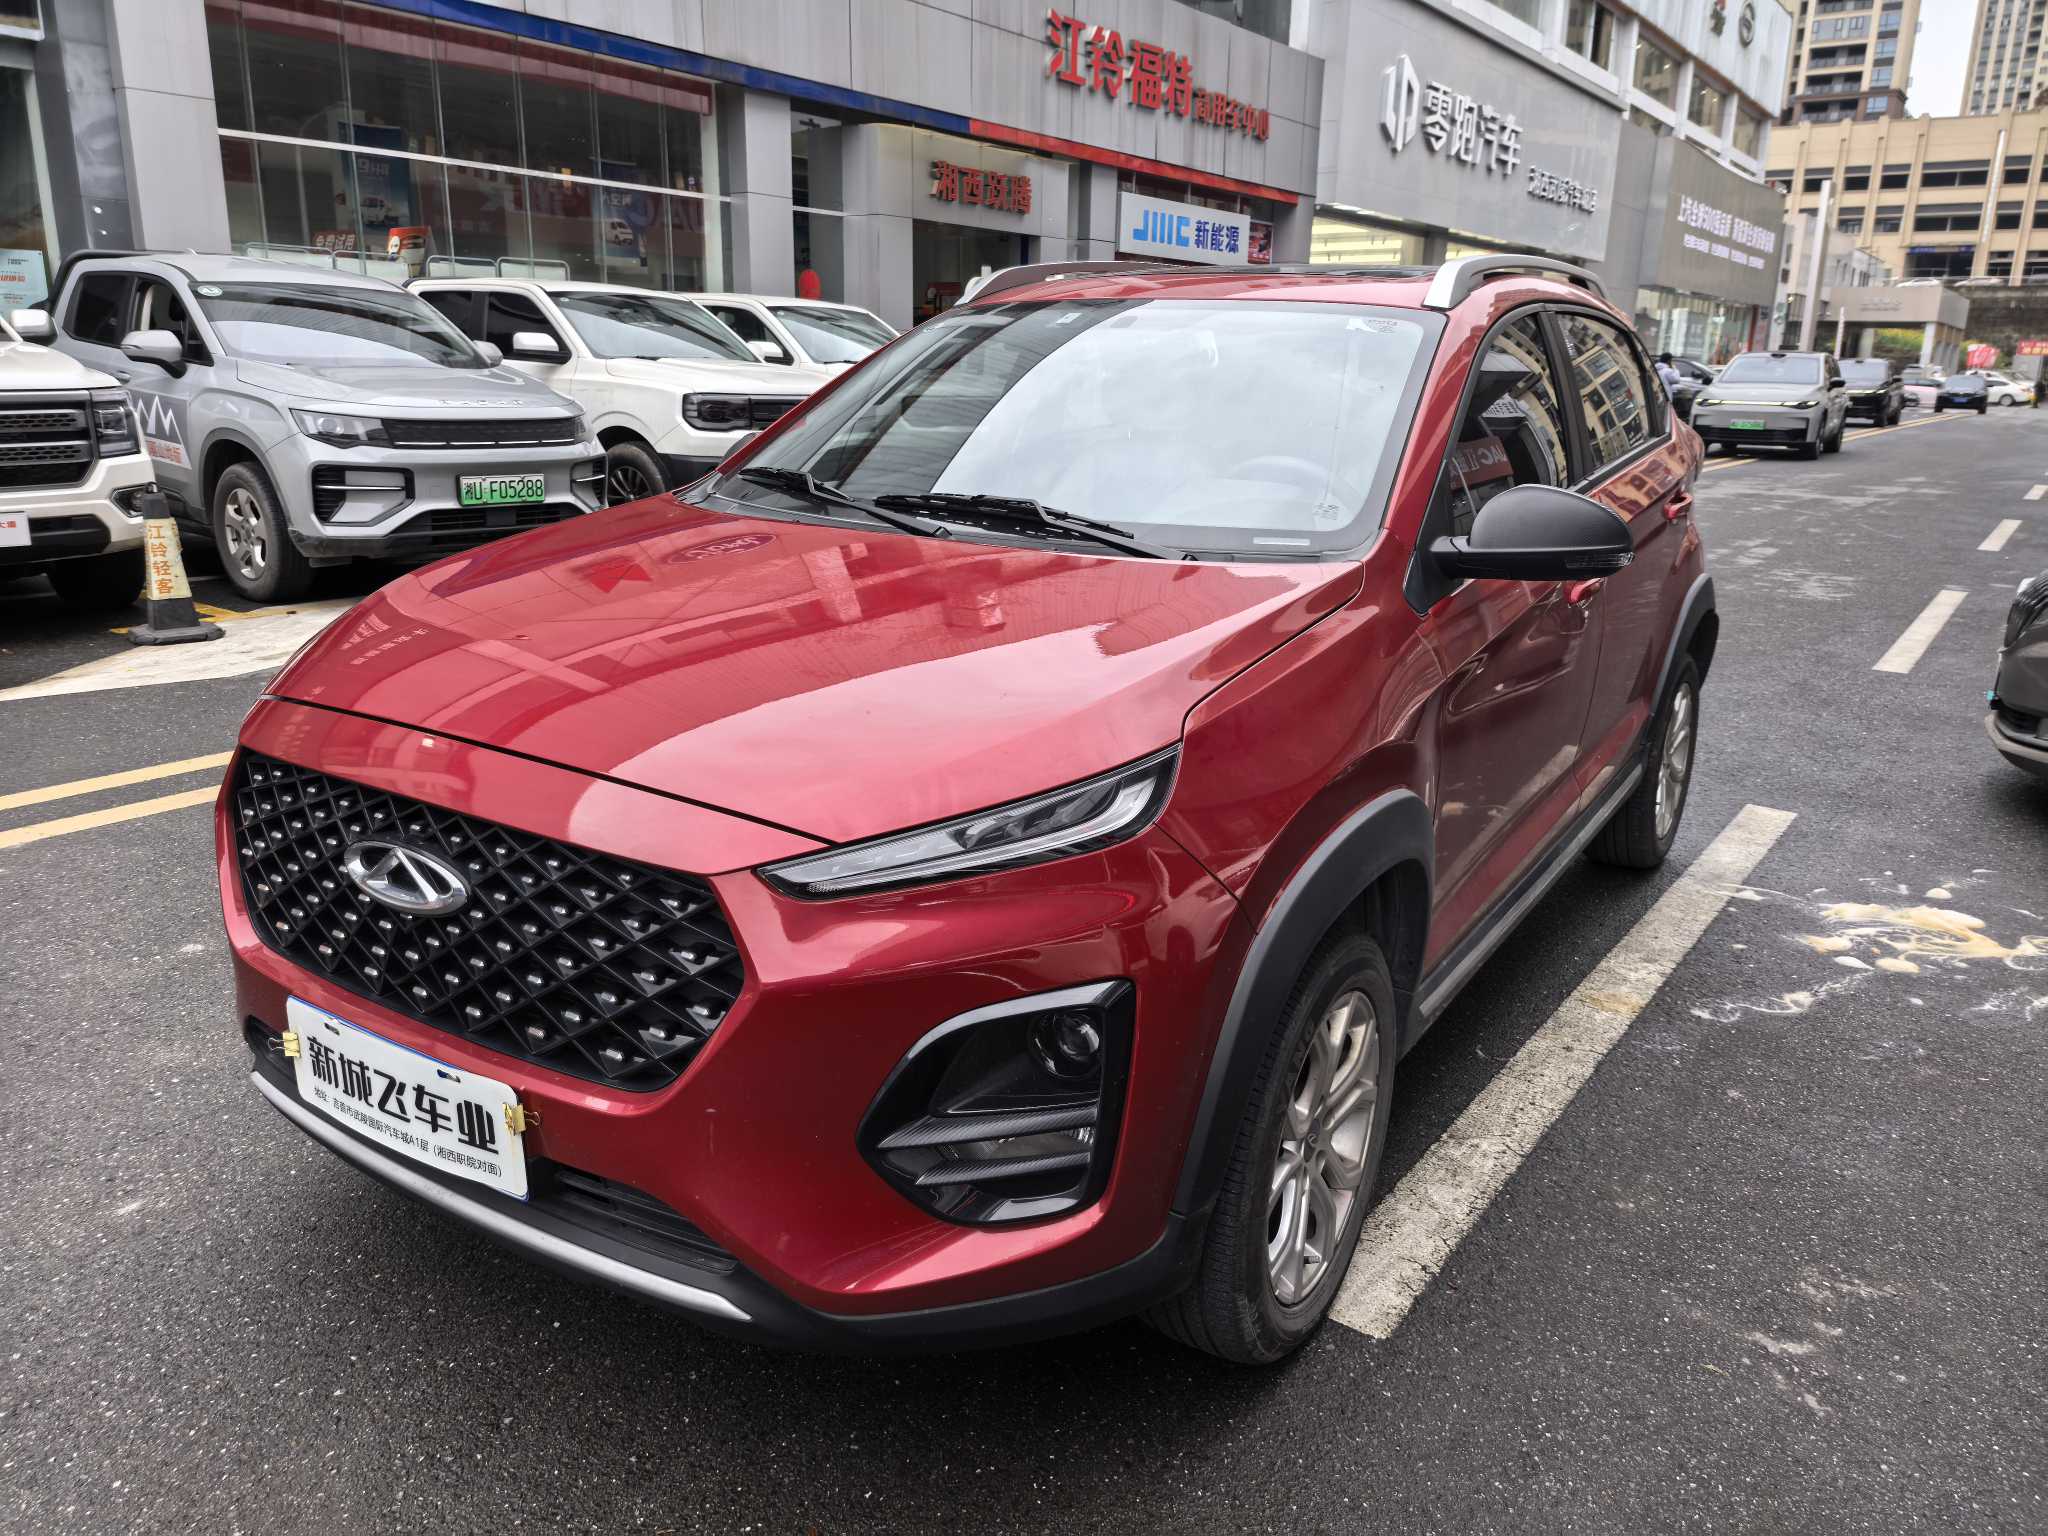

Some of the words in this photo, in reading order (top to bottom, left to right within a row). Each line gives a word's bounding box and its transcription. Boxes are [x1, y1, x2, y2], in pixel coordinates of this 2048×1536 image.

[1046, 8, 1193, 118] 江铃福特
[1194, 88, 1271, 142] 商用车中心
[1421, 80, 1525, 176] 零跑汽车
[930, 159, 1033, 215] 湘西跃腾
[1194, 219, 1240, 254] 新能源
[147, 524, 175, 596] 江铃轻客
[307, 1035, 500, 1155] 新城飞车业
